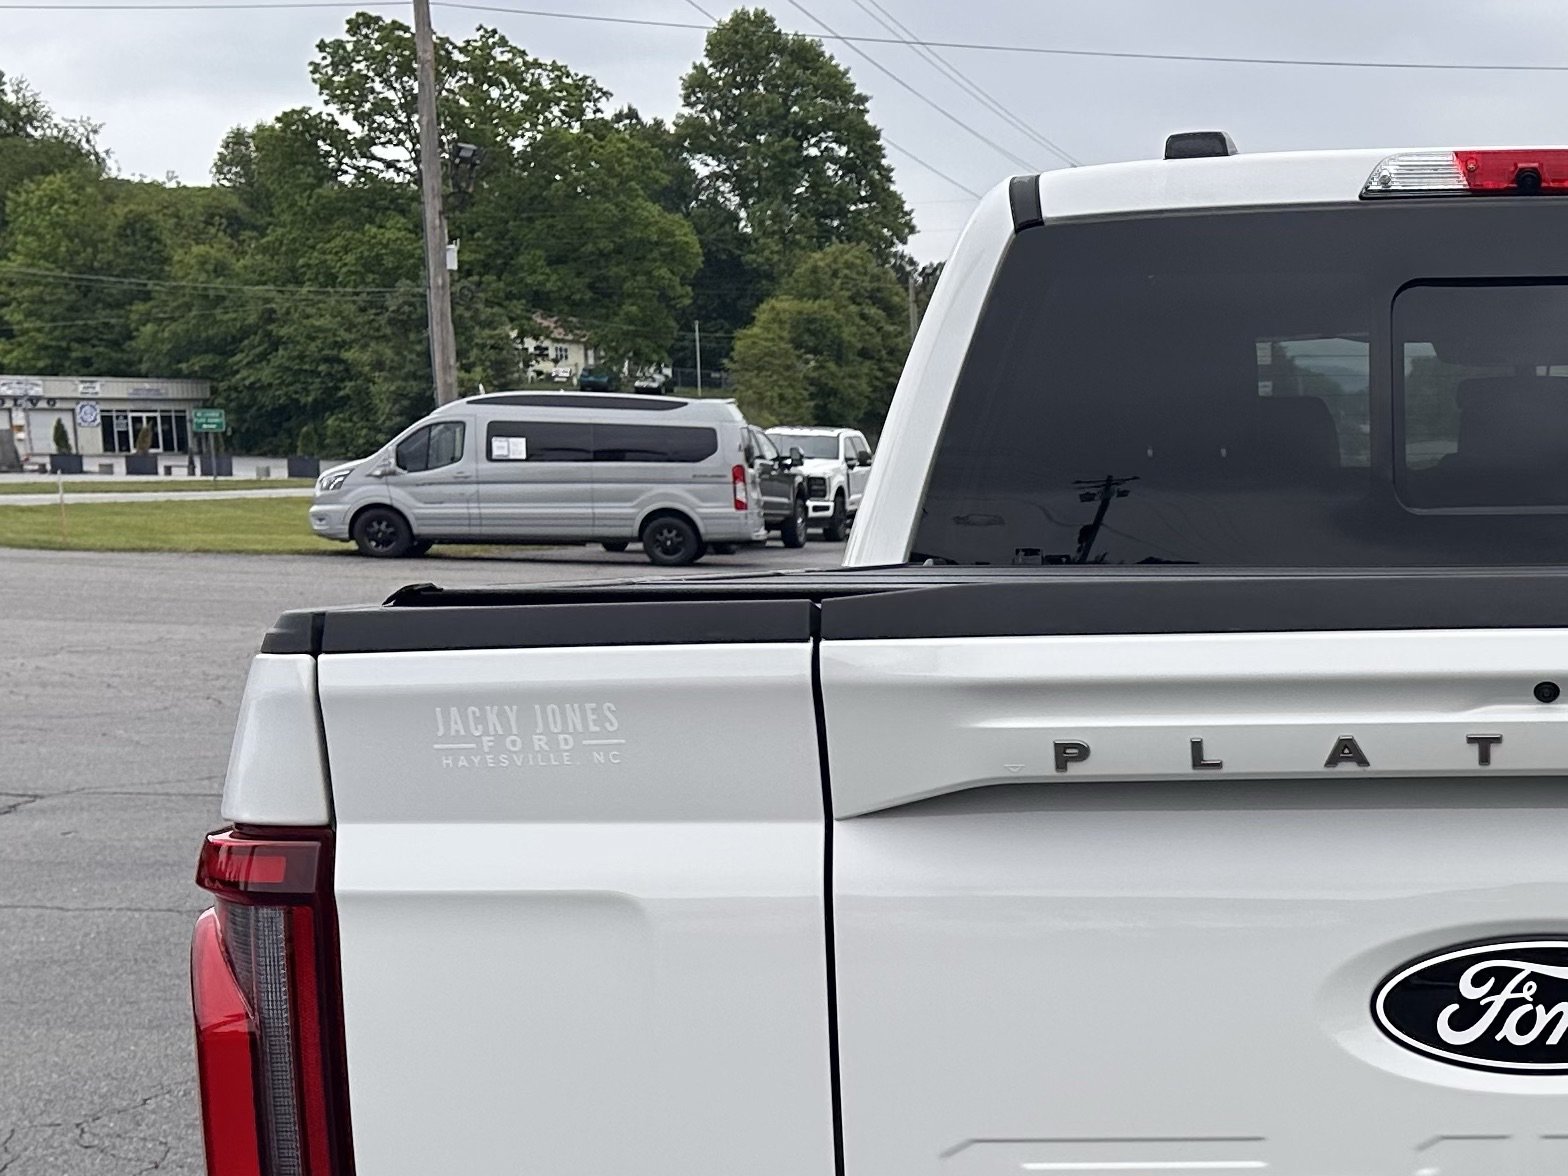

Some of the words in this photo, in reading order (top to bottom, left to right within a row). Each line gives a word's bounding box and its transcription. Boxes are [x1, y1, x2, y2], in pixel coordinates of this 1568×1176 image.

[434, 704, 519, 737] JACKY
[534, 702, 620, 734] JONES
[482, 734, 576, 753] FORD
[592, 750, 622, 764] NC
